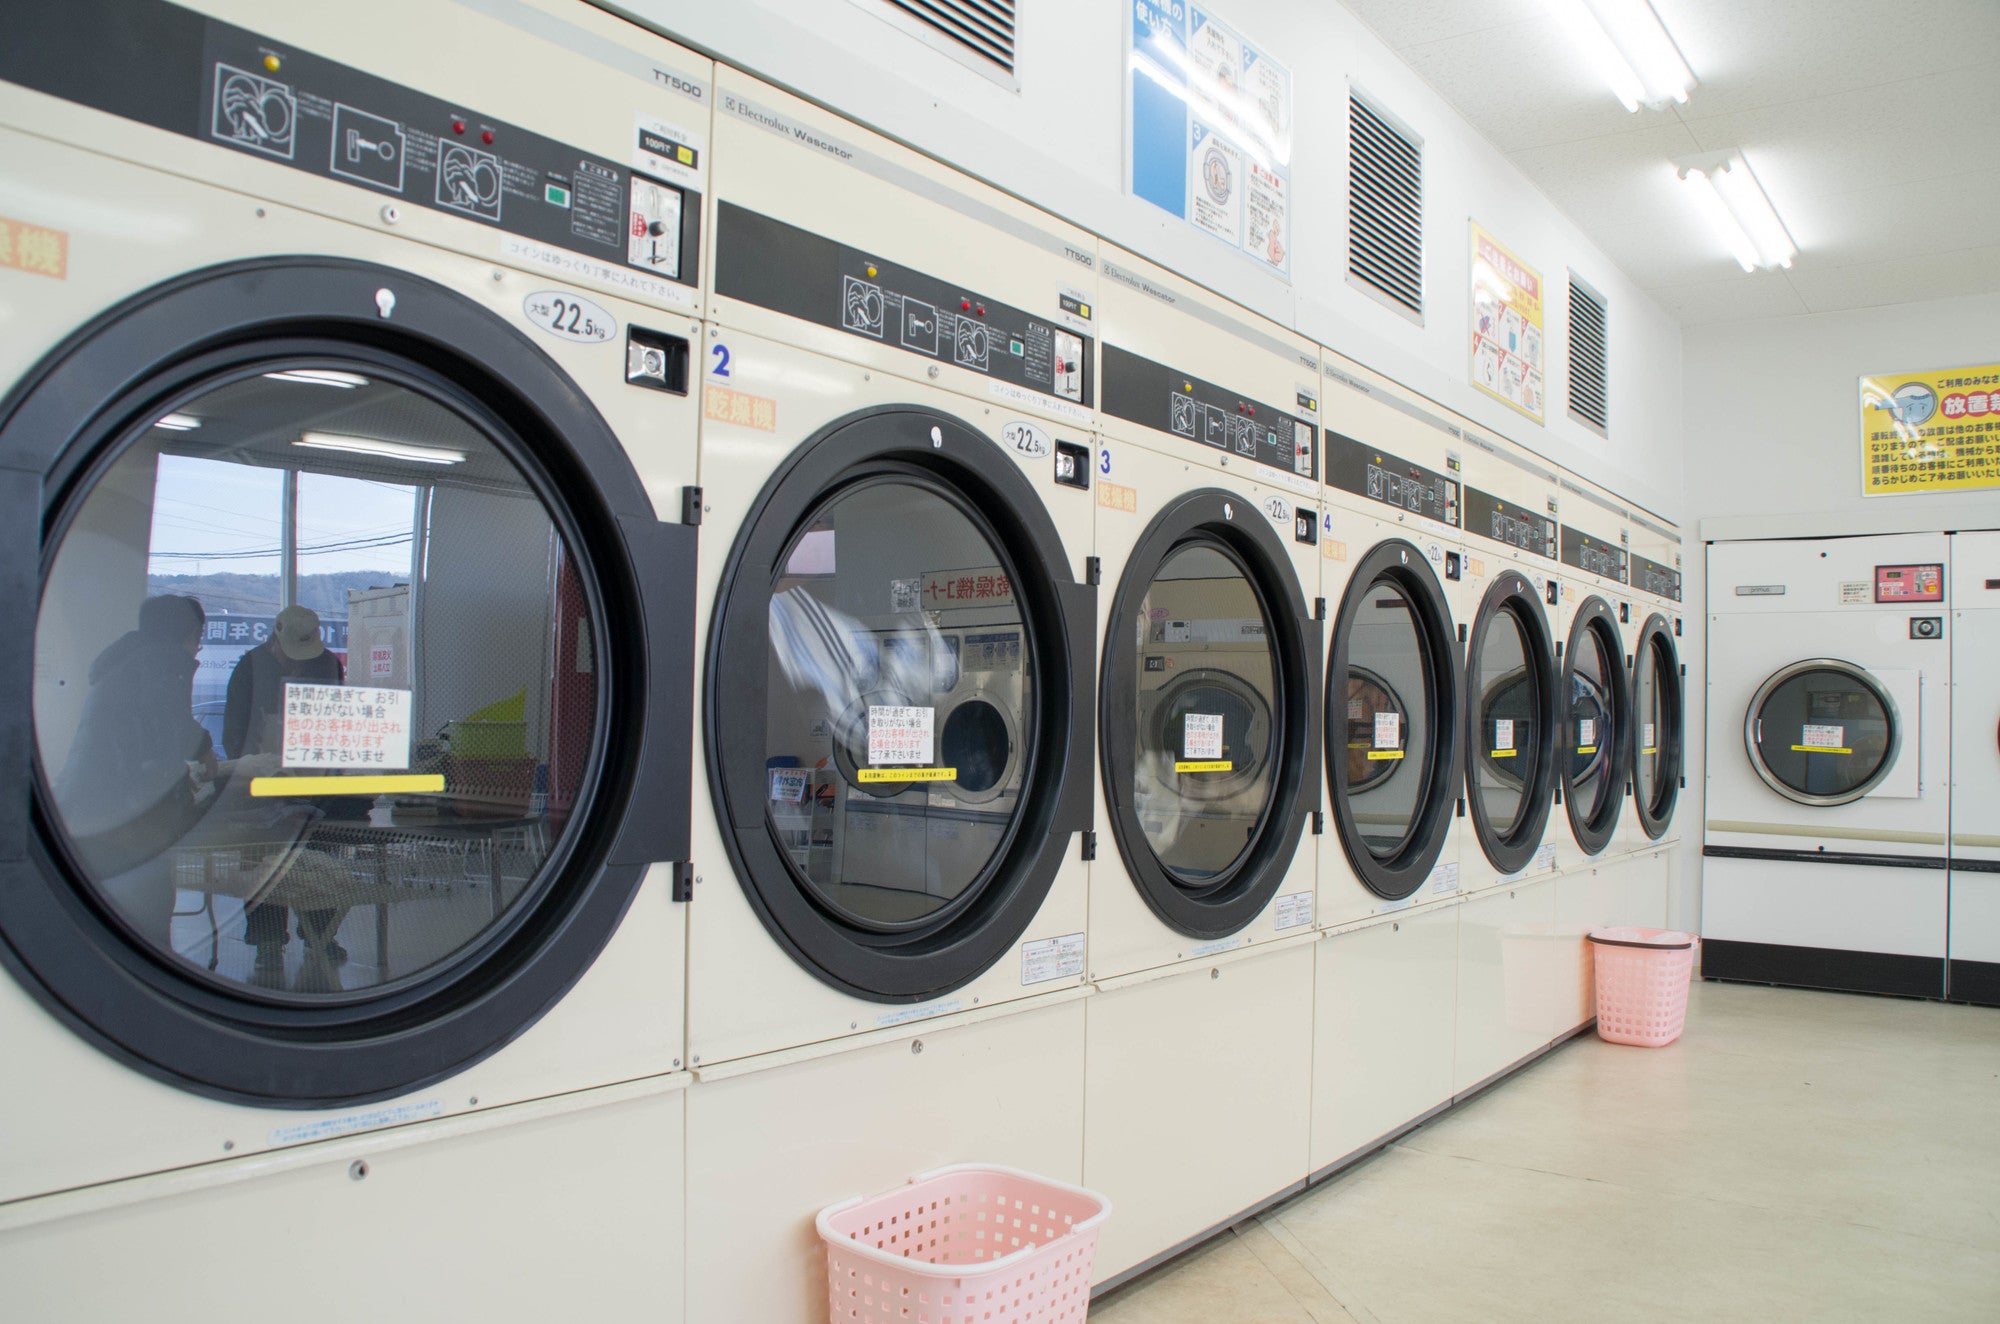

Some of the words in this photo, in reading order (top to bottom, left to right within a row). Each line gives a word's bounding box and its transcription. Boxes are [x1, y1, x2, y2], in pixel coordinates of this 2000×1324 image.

[1193, 11, 1199, 27] 1
[1244, 48, 1251, 65] 2
[653, 68, 702, 98] TT500
[738, 102, 790, 134] Electrolux
[793, 127, 854, 160] Wascator
[1193, 123, 1200, 141] 3
[1064, 246, 1092, 266] TT500
[1111, 268, 1140, 288] Electrolux
[1142, 282, 1176, 303] Wascator
[530, 303, 549, 317] 大型
[552, 299, 606, 339] 22.5kg
[712, 344, 731, 377] 2
[1937, 374, 1999, 389] ご利用のみなさ
[1100, 449, 1111, 475] 3
[1324, 514, 1331, 532] 4
[288, 686, 367, 703] 時間が過ぎて
[375, 690, 399, 705] お引
[287, 702, 387, 719] き取りがない場合
[287, 717, 402, 734] 他のお客様が出され
[287, 733, 385, 748] る場合があります
[286, 748, 385, 763] ご了承下さいませ
